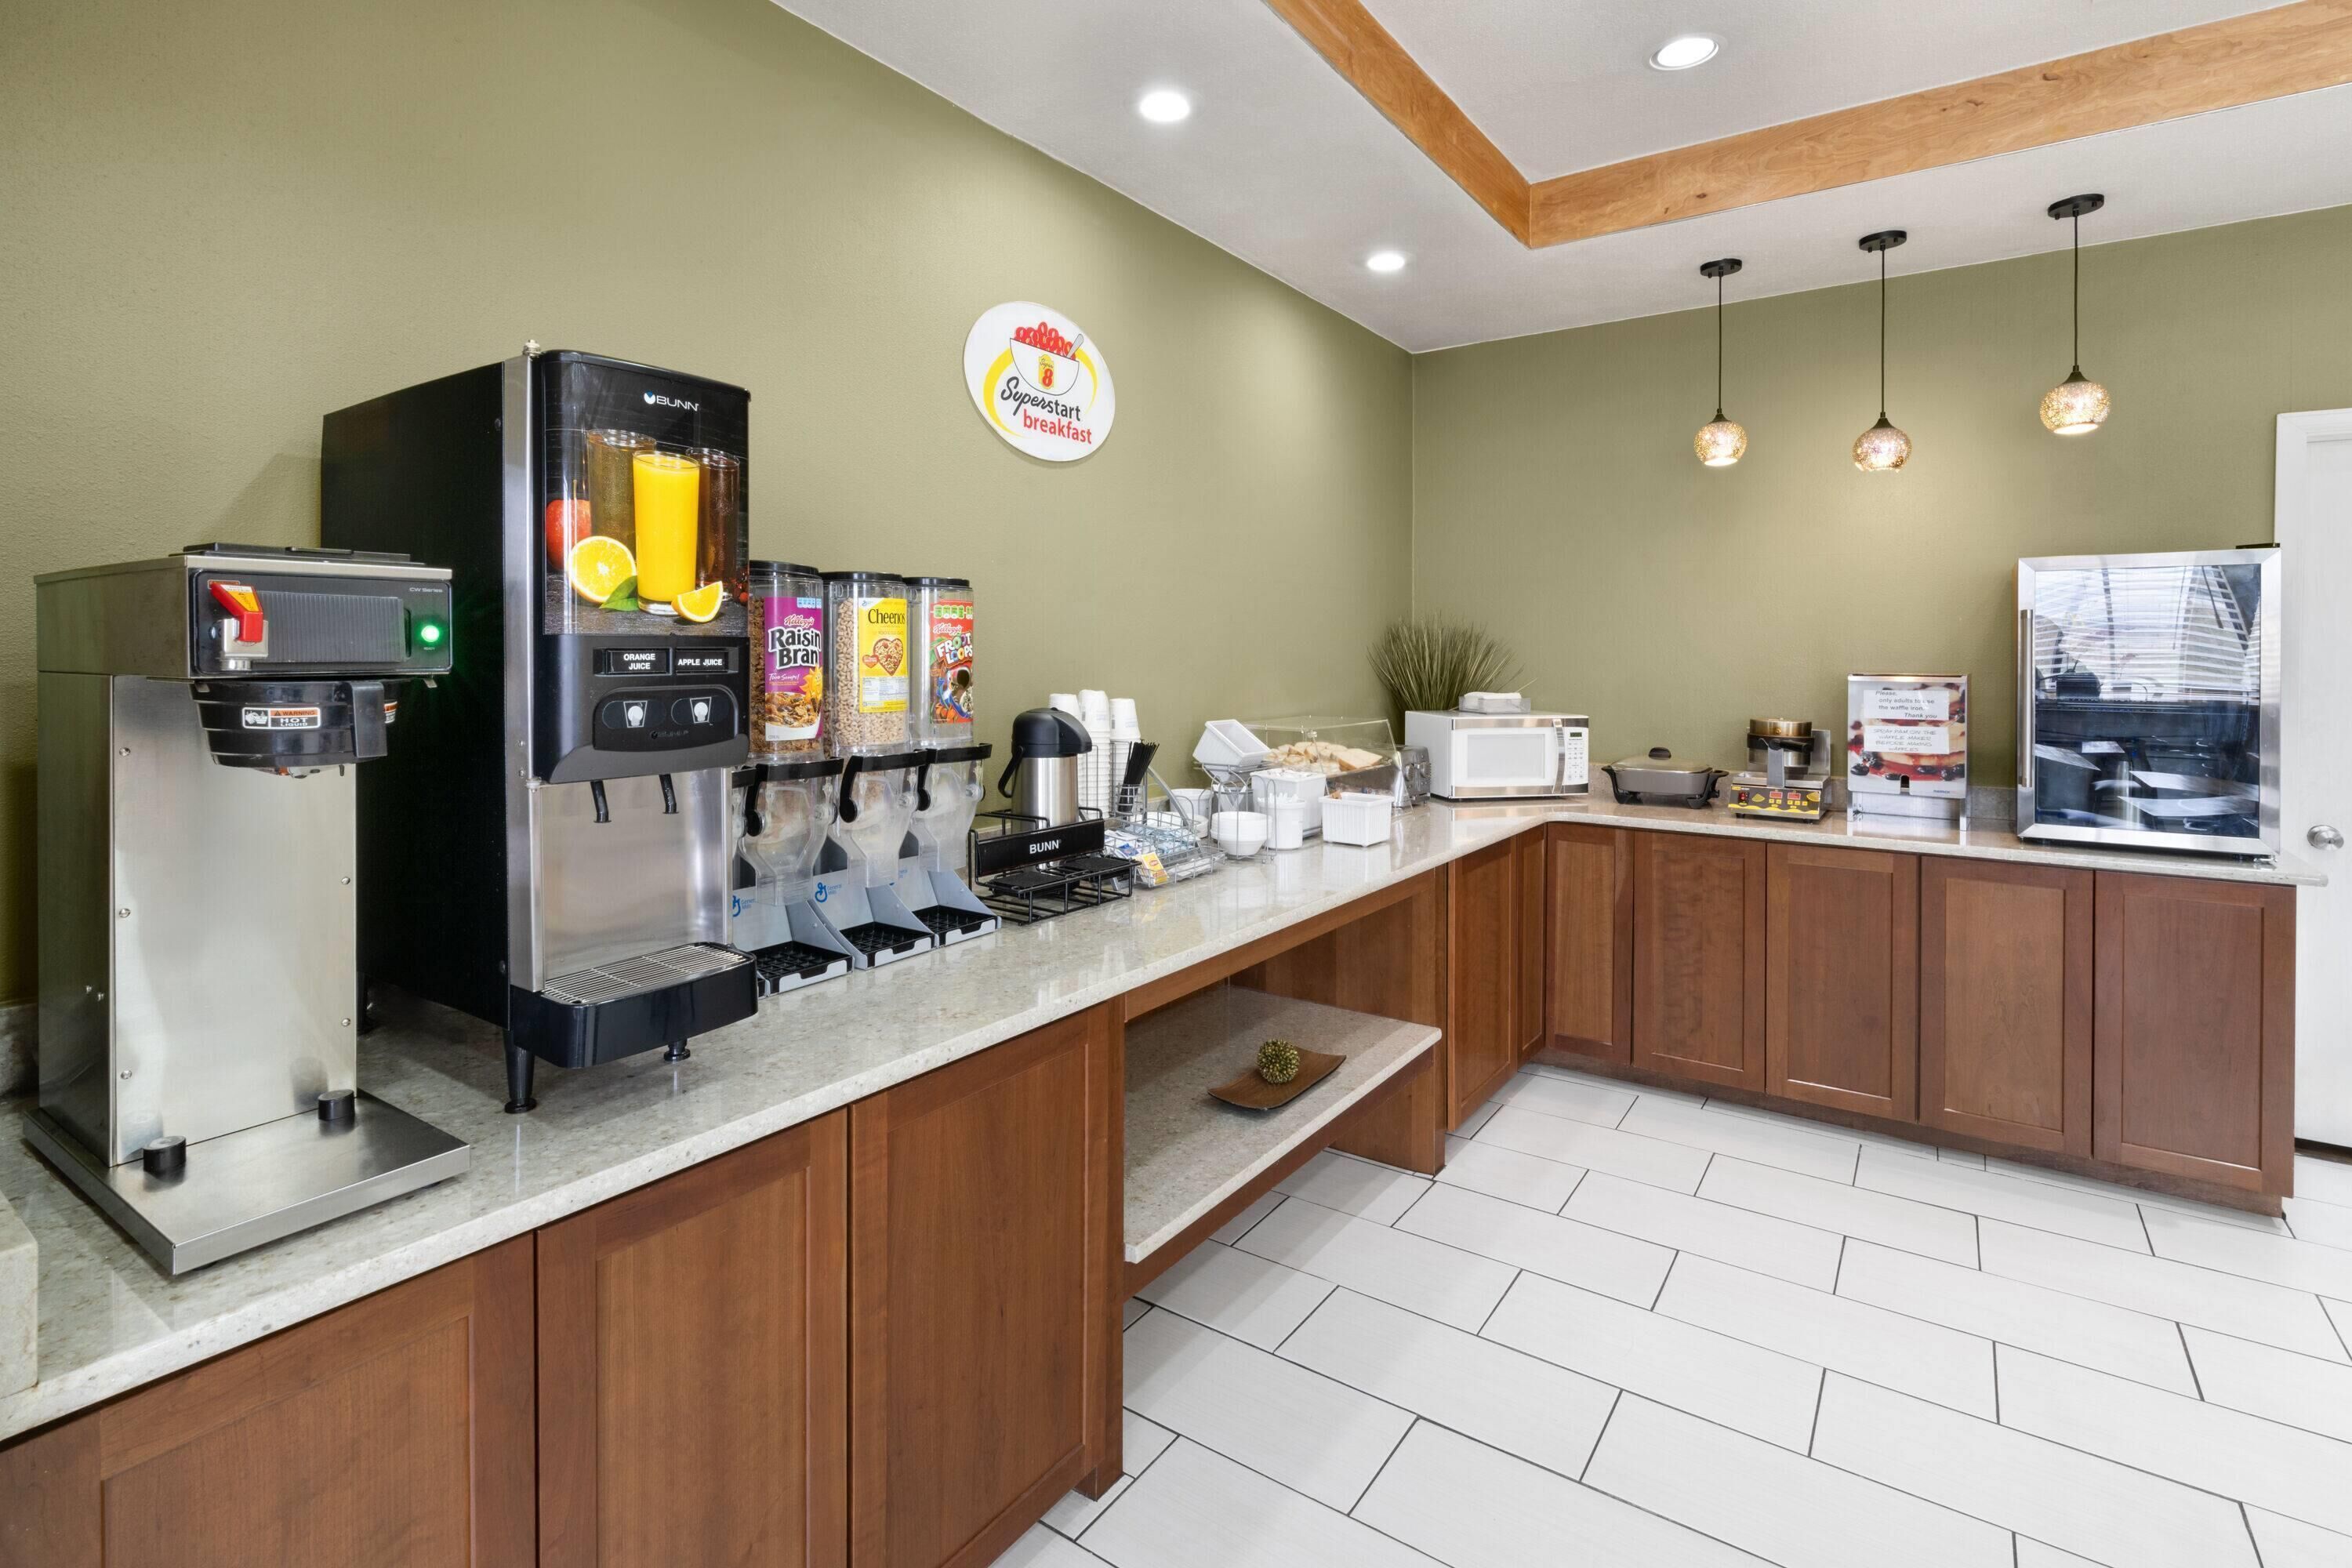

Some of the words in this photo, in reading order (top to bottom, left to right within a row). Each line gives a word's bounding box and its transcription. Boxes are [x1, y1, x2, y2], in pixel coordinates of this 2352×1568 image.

[1042, 368, 1054, 387] 8
[656, 395, 699, 412] BUNN
[1000, 376, 1081, 421] Superstart
[1022, 408, 1092, 445] breakfast
[784, 614, 815, 628] Kellogg's
[868, 608, 906, 625] Cheerios
[933, 622, 963, 636] Kellogg's
[770, 628, 821, 651] Raisin
[936, 632, 971, 658] FROOT
[778, 647, 818, 667] Bran
[946, 644, 973, 665] LOOPS
[1029, 840, 1059, 855] BUNN
